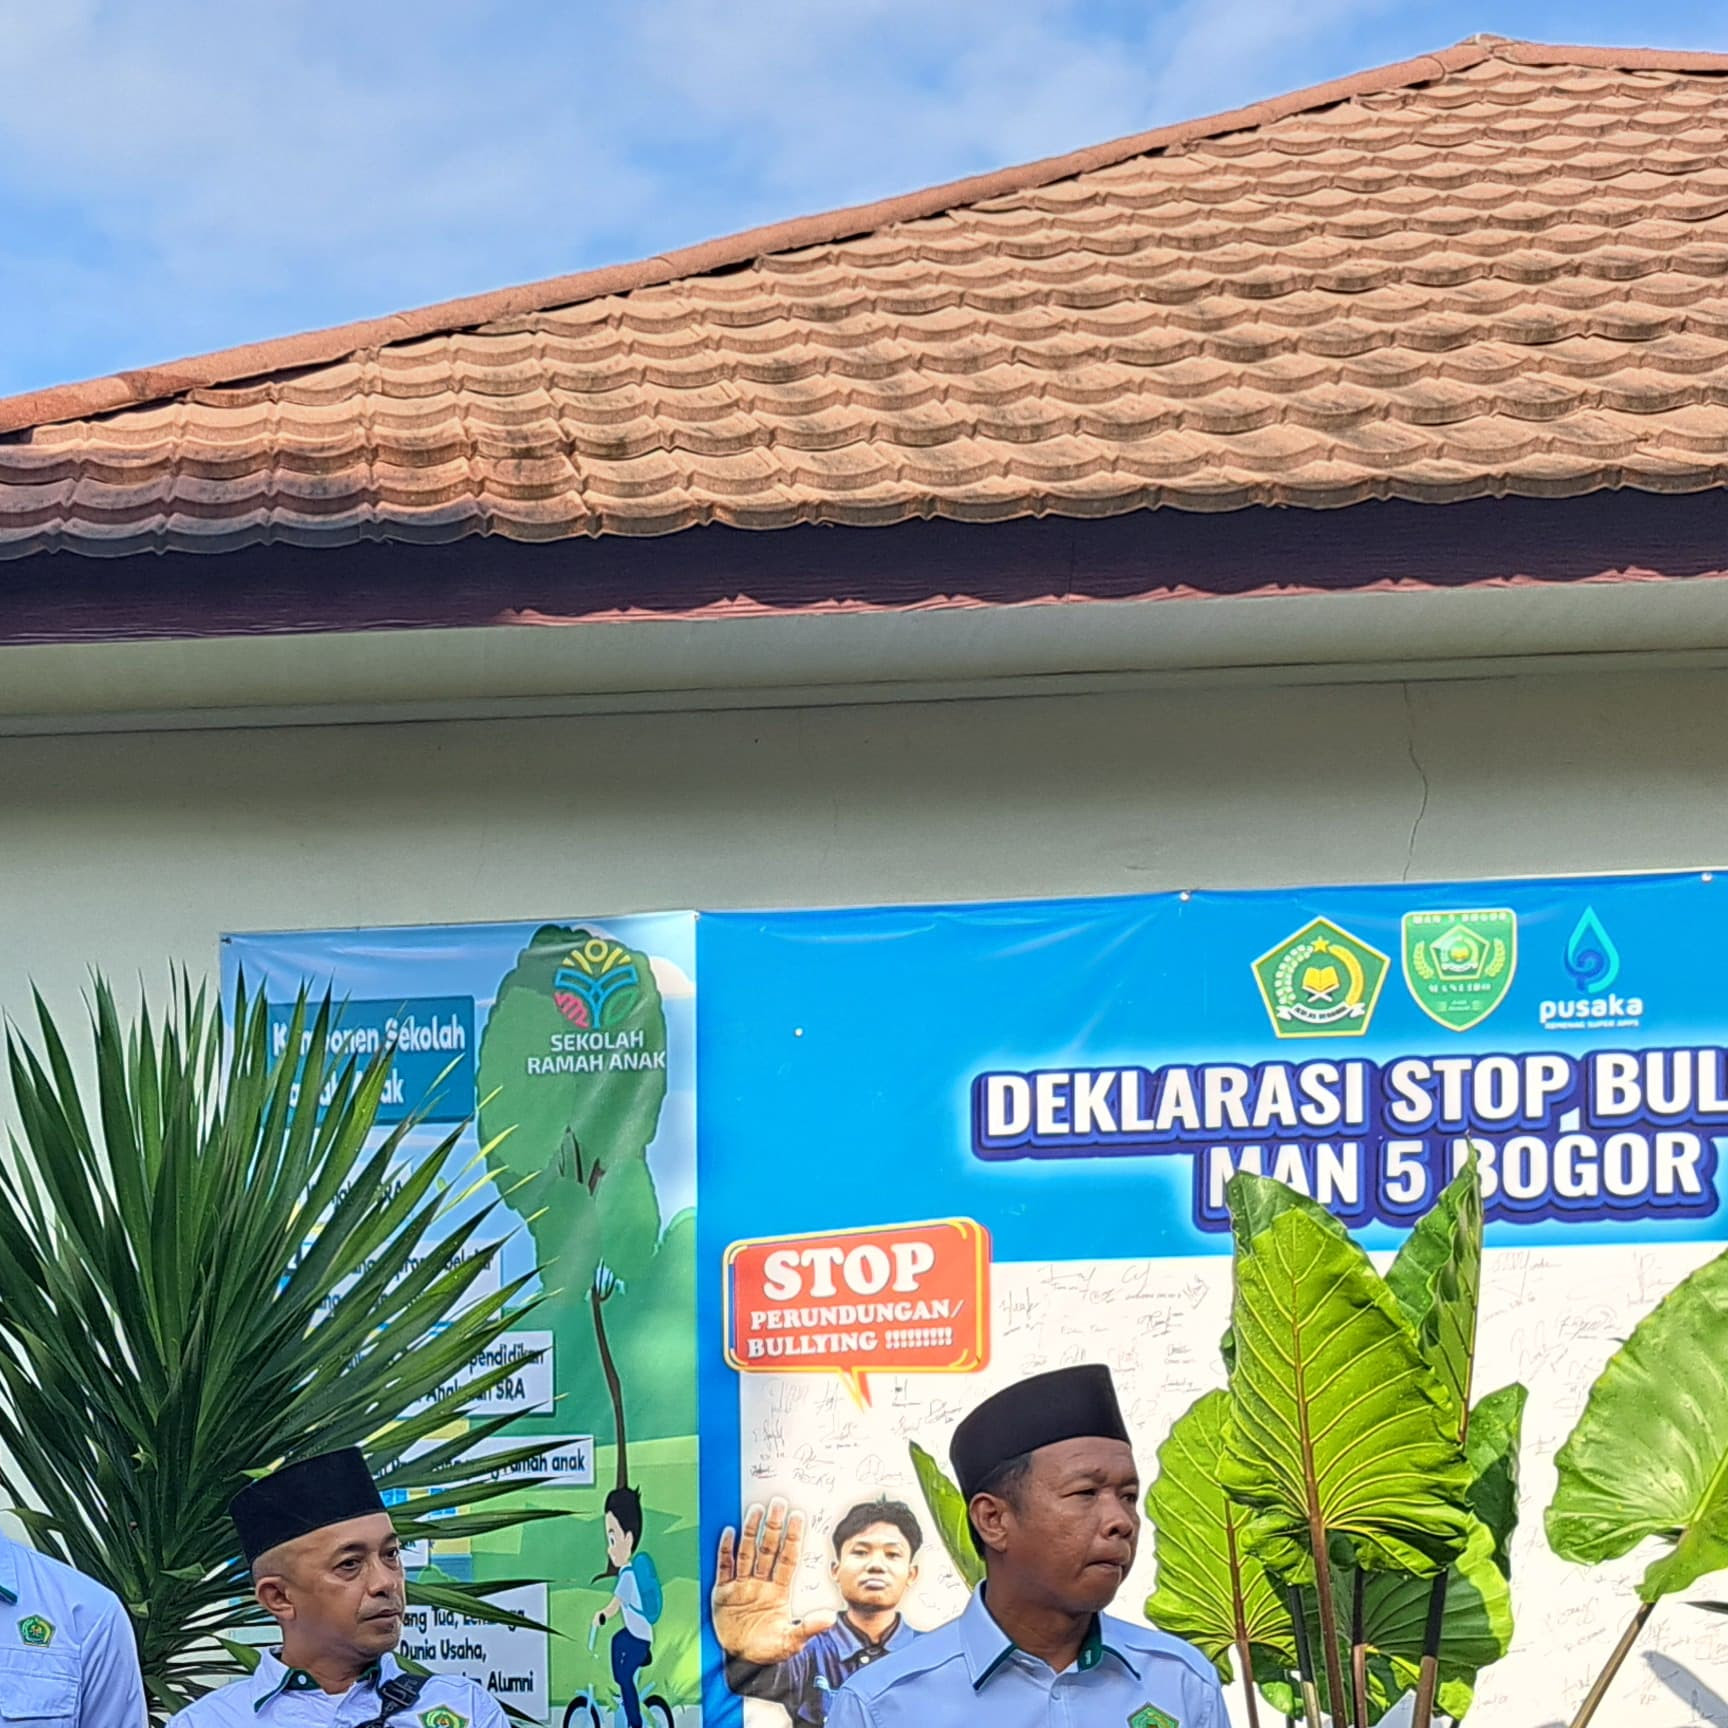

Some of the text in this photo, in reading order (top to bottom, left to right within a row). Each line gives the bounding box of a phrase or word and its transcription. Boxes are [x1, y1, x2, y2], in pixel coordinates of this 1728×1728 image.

[1539, 993, 1643, 1024] pusaka
[384, 1014, 466, 1050] Sekolah
[551, 1030, 644, 1052] SEKOLAH
[527, 1051, 666, 1075] RAMAH ANAK
[988, 1061, 1364, 1137] DEKLARASI
[1390, 1055, 1570, 1123] STOP
[1209, 1131, 1702, 1208] MAN 5 BOGOR
[762, 1241, 935, 1301] STOP
[747, 1331, 879, 1358] BULLYING
[496, 1377, 526, 1401] SRA
[552, 1448, 586, 1472] anak
[400, 1637, 487, 1663] Dunia Usaha,
[487, 1670, 534, 1693] Alumni
